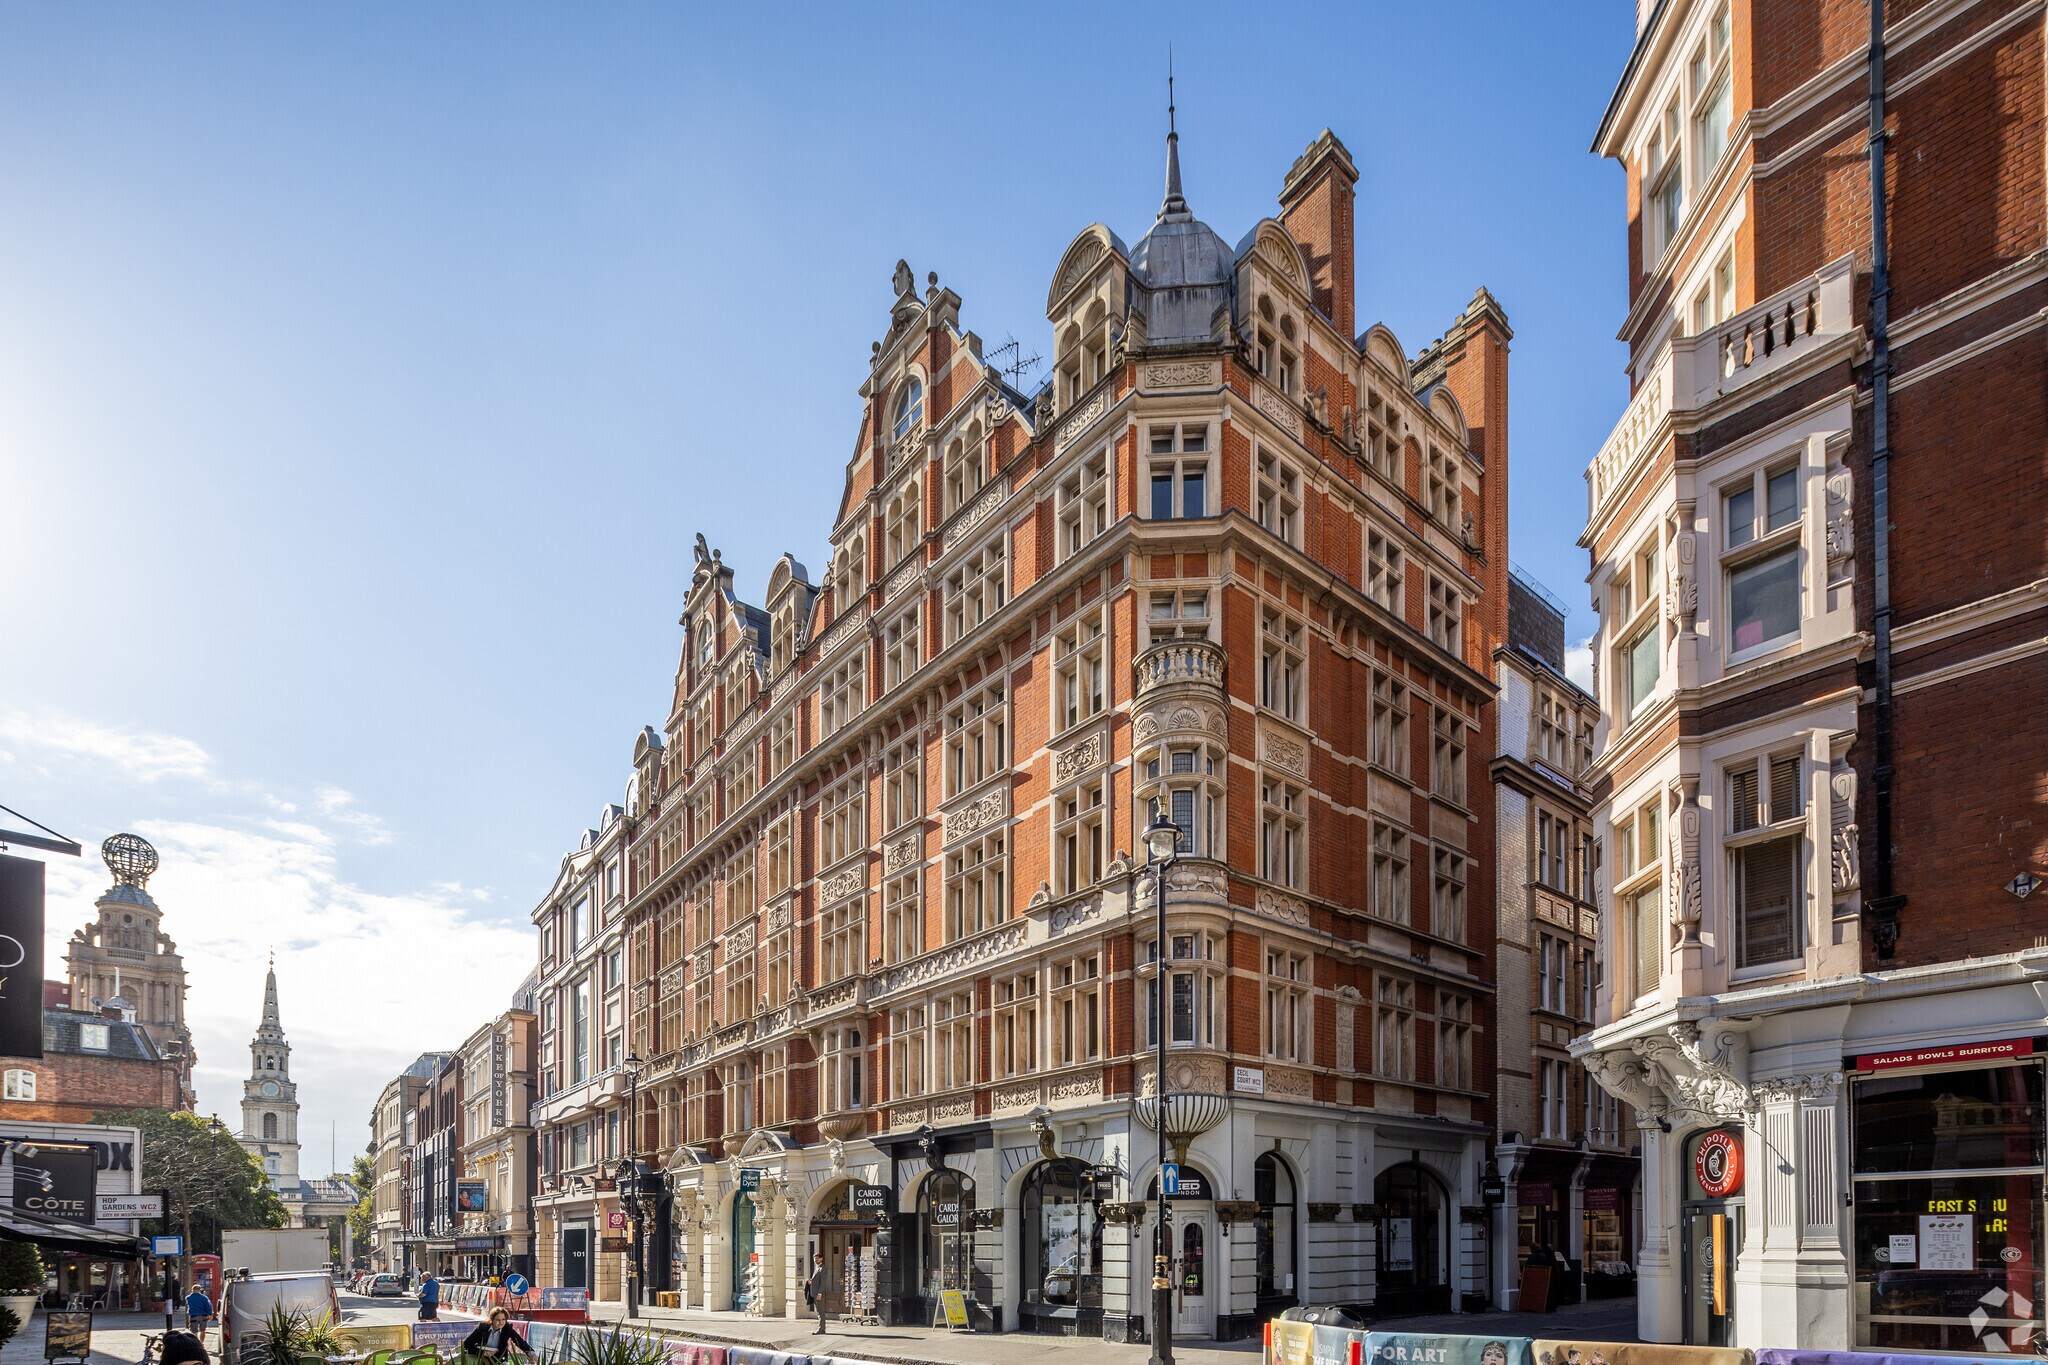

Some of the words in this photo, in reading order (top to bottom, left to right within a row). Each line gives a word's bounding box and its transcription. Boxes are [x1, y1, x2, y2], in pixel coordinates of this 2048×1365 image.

[2014, 876, 2033, 893] H
[2018, 888, 2027, 896] 12
[495, 1035, 503, 1071] DUKE
[1873, 1055, 1913, 1065] SALADS
[1917, 1051, 1954, 1060] BOWLS
[1959, 1044, 2014, 1056] BURRITOS
[1236, 1069, 1249, 1077] CECIL
[1236, 1076, 1251, 1085] COURT
[1251, 1078, 1262, 1086] WC2
[493, 1080, 503, 1126] YORK'S
[1696, 1133, 1734, 1164] CHIPOTLE
[1699, 1174, 1723, 1192] MEXICAN
[1722, 1163, 1735, 1187] GRILL
[857, 1189, 882, 1198] CARDS
[25, 1196, 85, 1210] CÔTE
[102, 1203, 137, 1211] GARDENS
[856, 1198, 884, 1206] GALORE
[1928, 1200, 1964, 1213] FAST
[938, 1203, 959, 1213] CARDS
[936, 1213, 959, 1224] GALOR
[572, 1250, 586, 1258] 101
[879, 1246, 888, 1256] 95
[1373, 1346, 1408, 1361] FOR
[1411, 1347, 1448, 1363] ART
